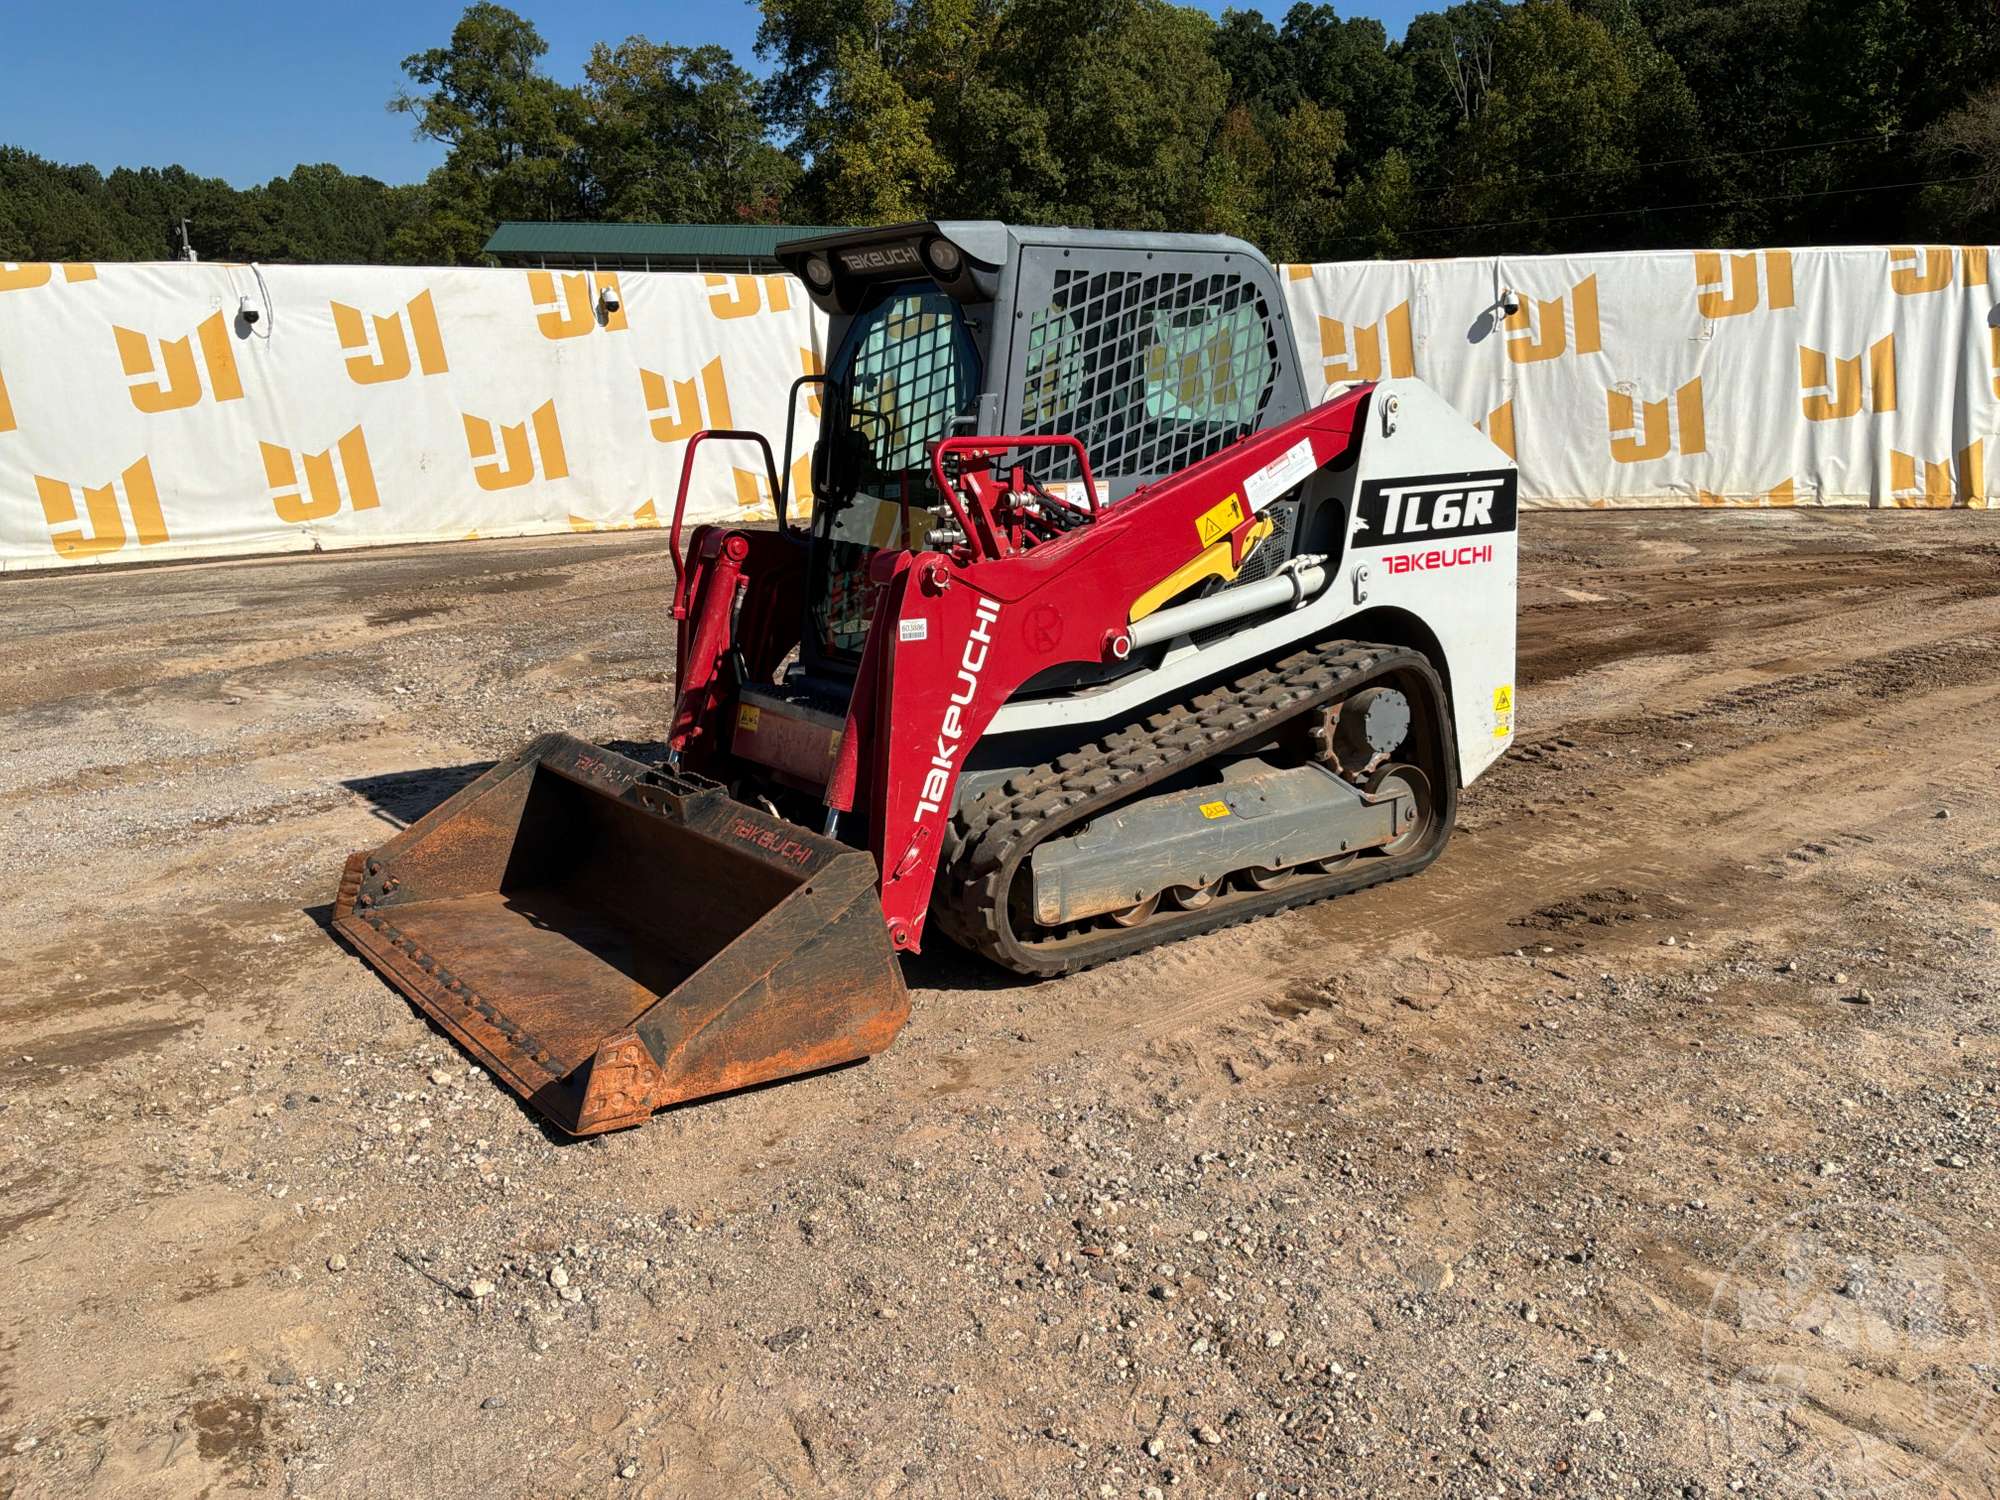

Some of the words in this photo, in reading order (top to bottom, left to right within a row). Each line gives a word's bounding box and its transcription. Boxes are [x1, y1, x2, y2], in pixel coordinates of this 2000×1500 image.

[1379, 478, 1505, 536] TL6R
[1382, 544, 1493, 575] TAKEUCHI
[913, 597, 1001, 823] TAKEUCHI
